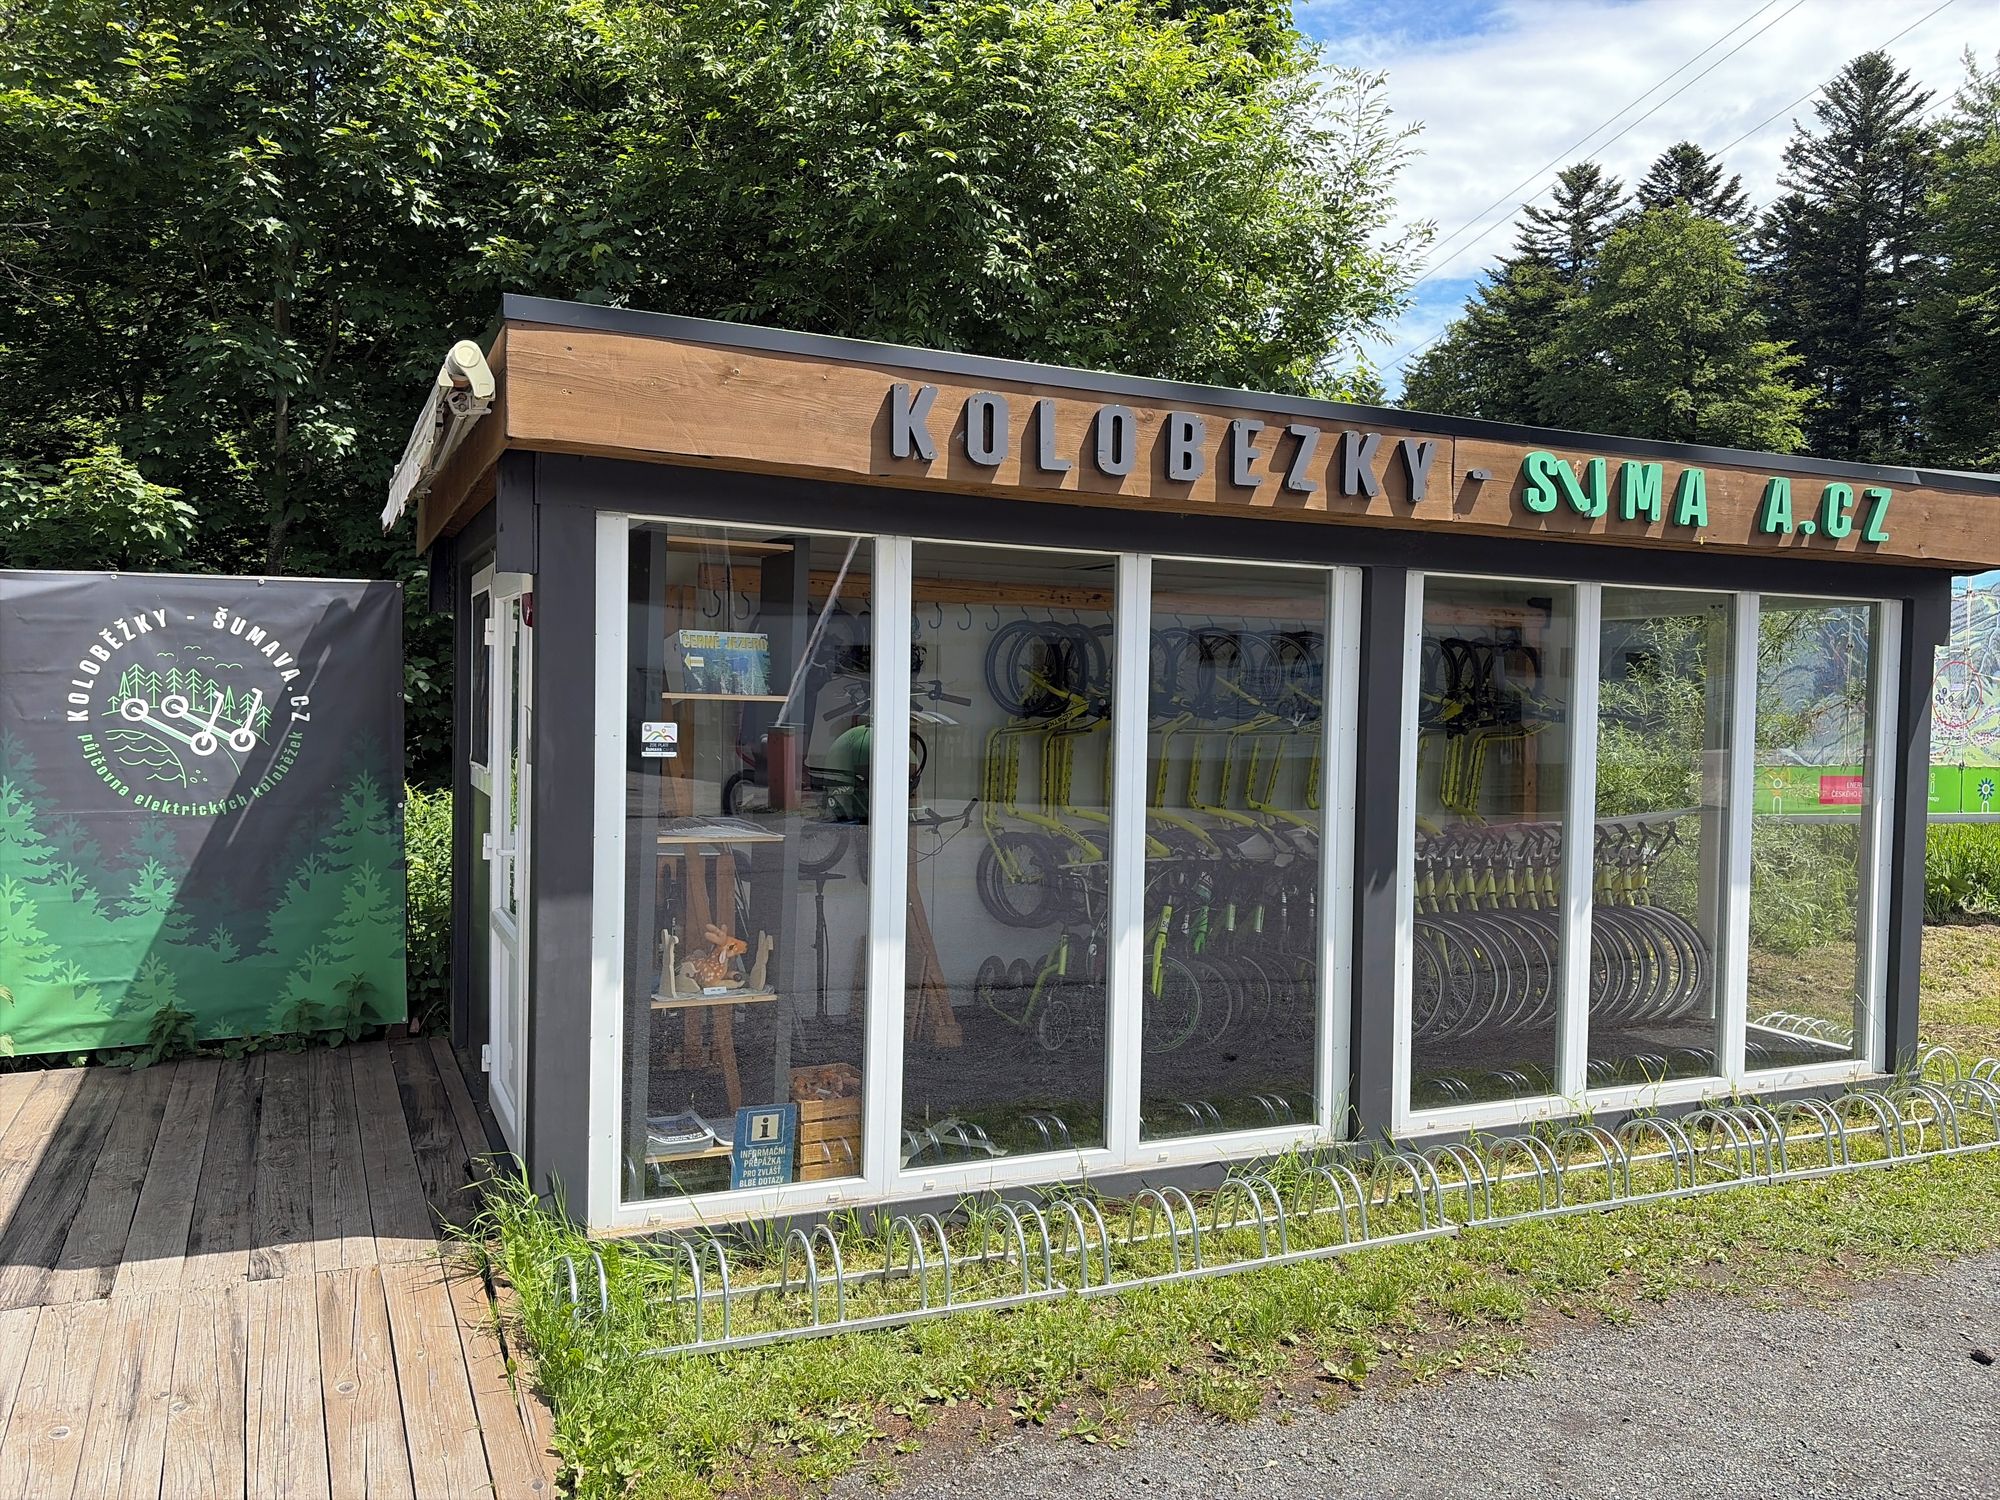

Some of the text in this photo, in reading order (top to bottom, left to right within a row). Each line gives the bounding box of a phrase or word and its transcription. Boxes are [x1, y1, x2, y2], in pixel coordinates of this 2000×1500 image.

[67, 609, 167, 722] KOLOBĚŽKY
[213, 606, 311, 722] ŠUMAVA.CZ
[77, 731, 303, 817] půjčovna elektrických koloběžek
[740, 1145, 786, 1159] INFORMAČNÍ
[742, 1169, 757, 1178] PRO
[758, 1175, 785, 1186] DOTAZY
